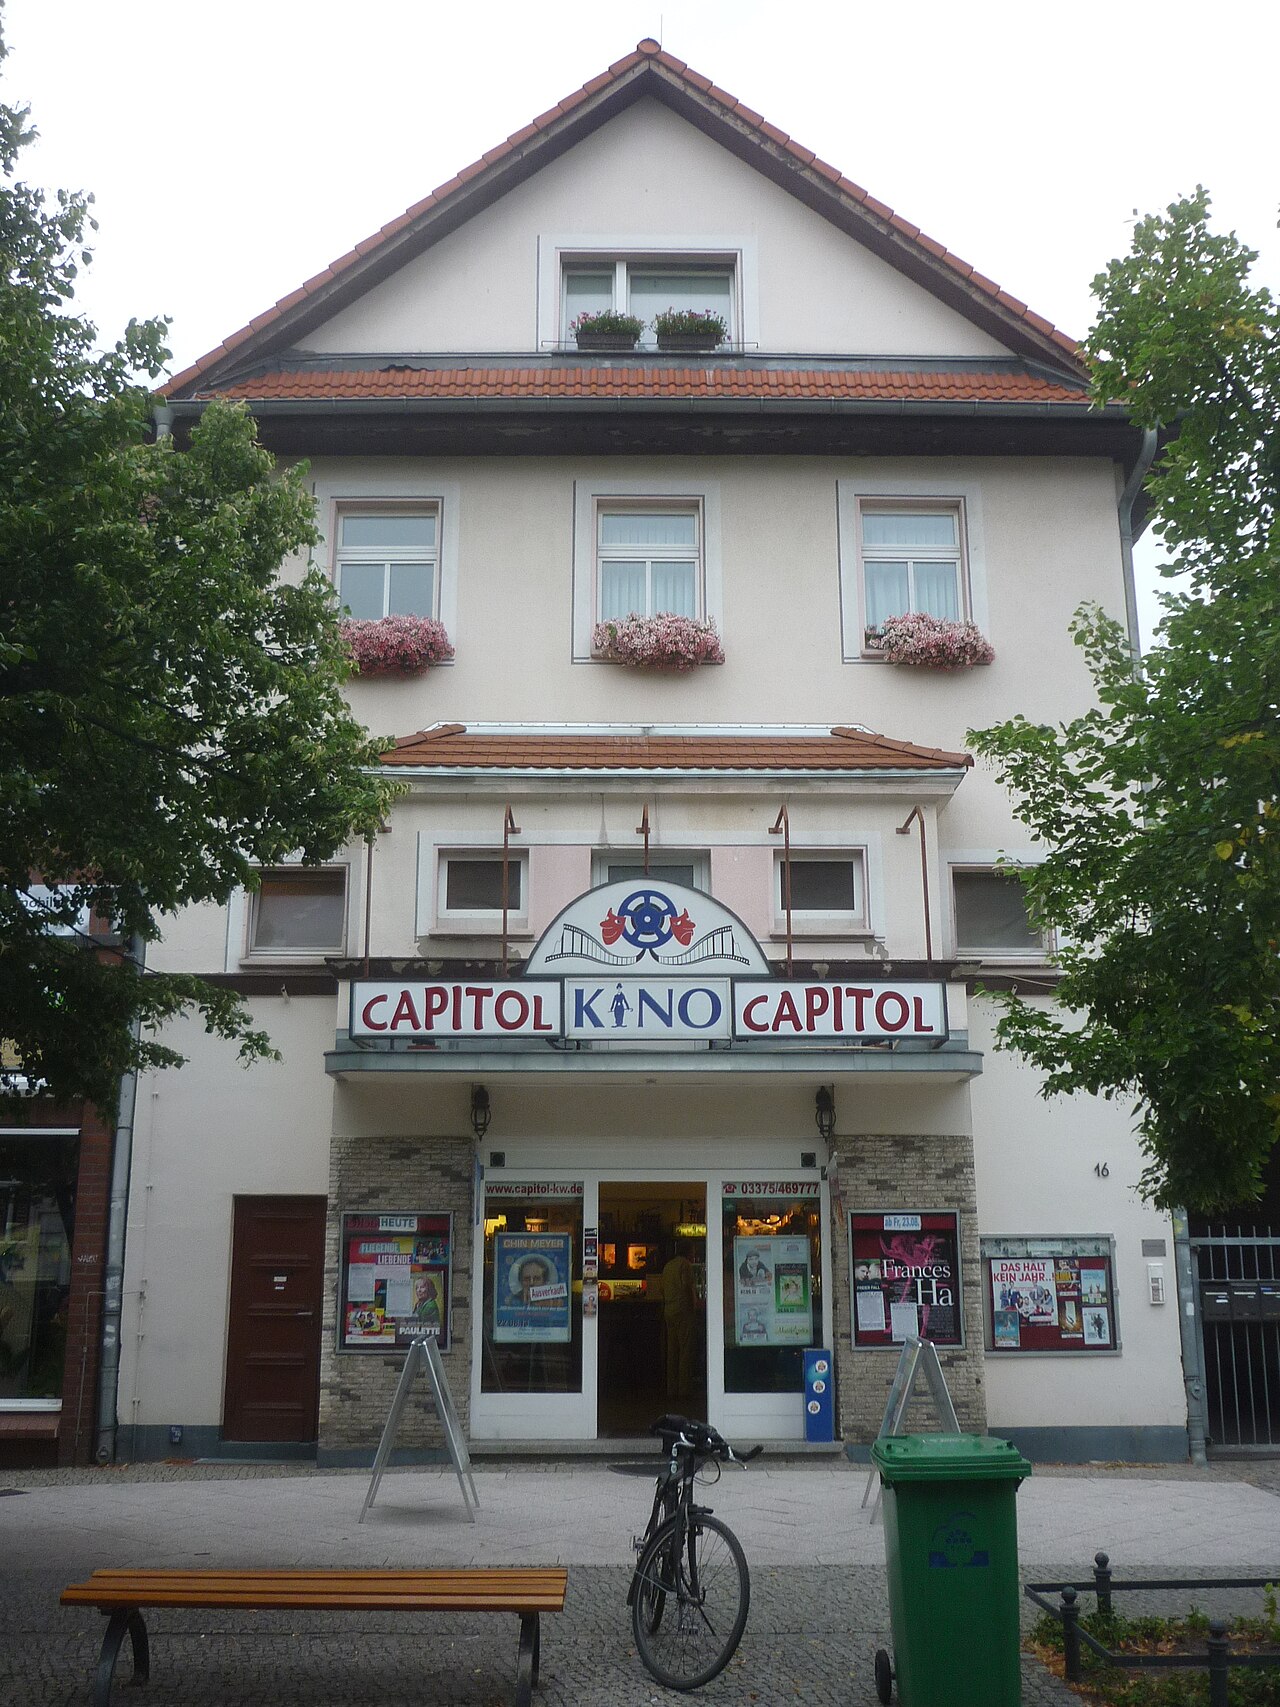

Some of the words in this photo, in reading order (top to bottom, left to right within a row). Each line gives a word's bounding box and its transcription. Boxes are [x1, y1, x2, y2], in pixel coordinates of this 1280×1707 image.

[361, 985, 552, 1031] CAPITOL
[742, 986, 934, 1032] CAPITOL
[1094, 1162, 1110, 1177] 16
[486, 1184, 583, 1196] www.capitol-kw.de
[741, 1183, 819, 1195] 03375/469777
[381, 1218, 415, 1228] HEUTE
[503, 1239, 528, 1248] CHIN
[530, 1239, 564, 1248] MEYER
[377, 1254, 412, 1265] LIEBENDE
[882, 1259, 951, 1278] Frances
[1000, 1262, 1021, 1272] DAS
[993, 1272, 1016, 1283] KEIN
[531, 1284, 565, 1298] Ausverkauft
[914, 1278, 955, 1307] Ha
[399, 1327, 441, 1335] PAULETTE
